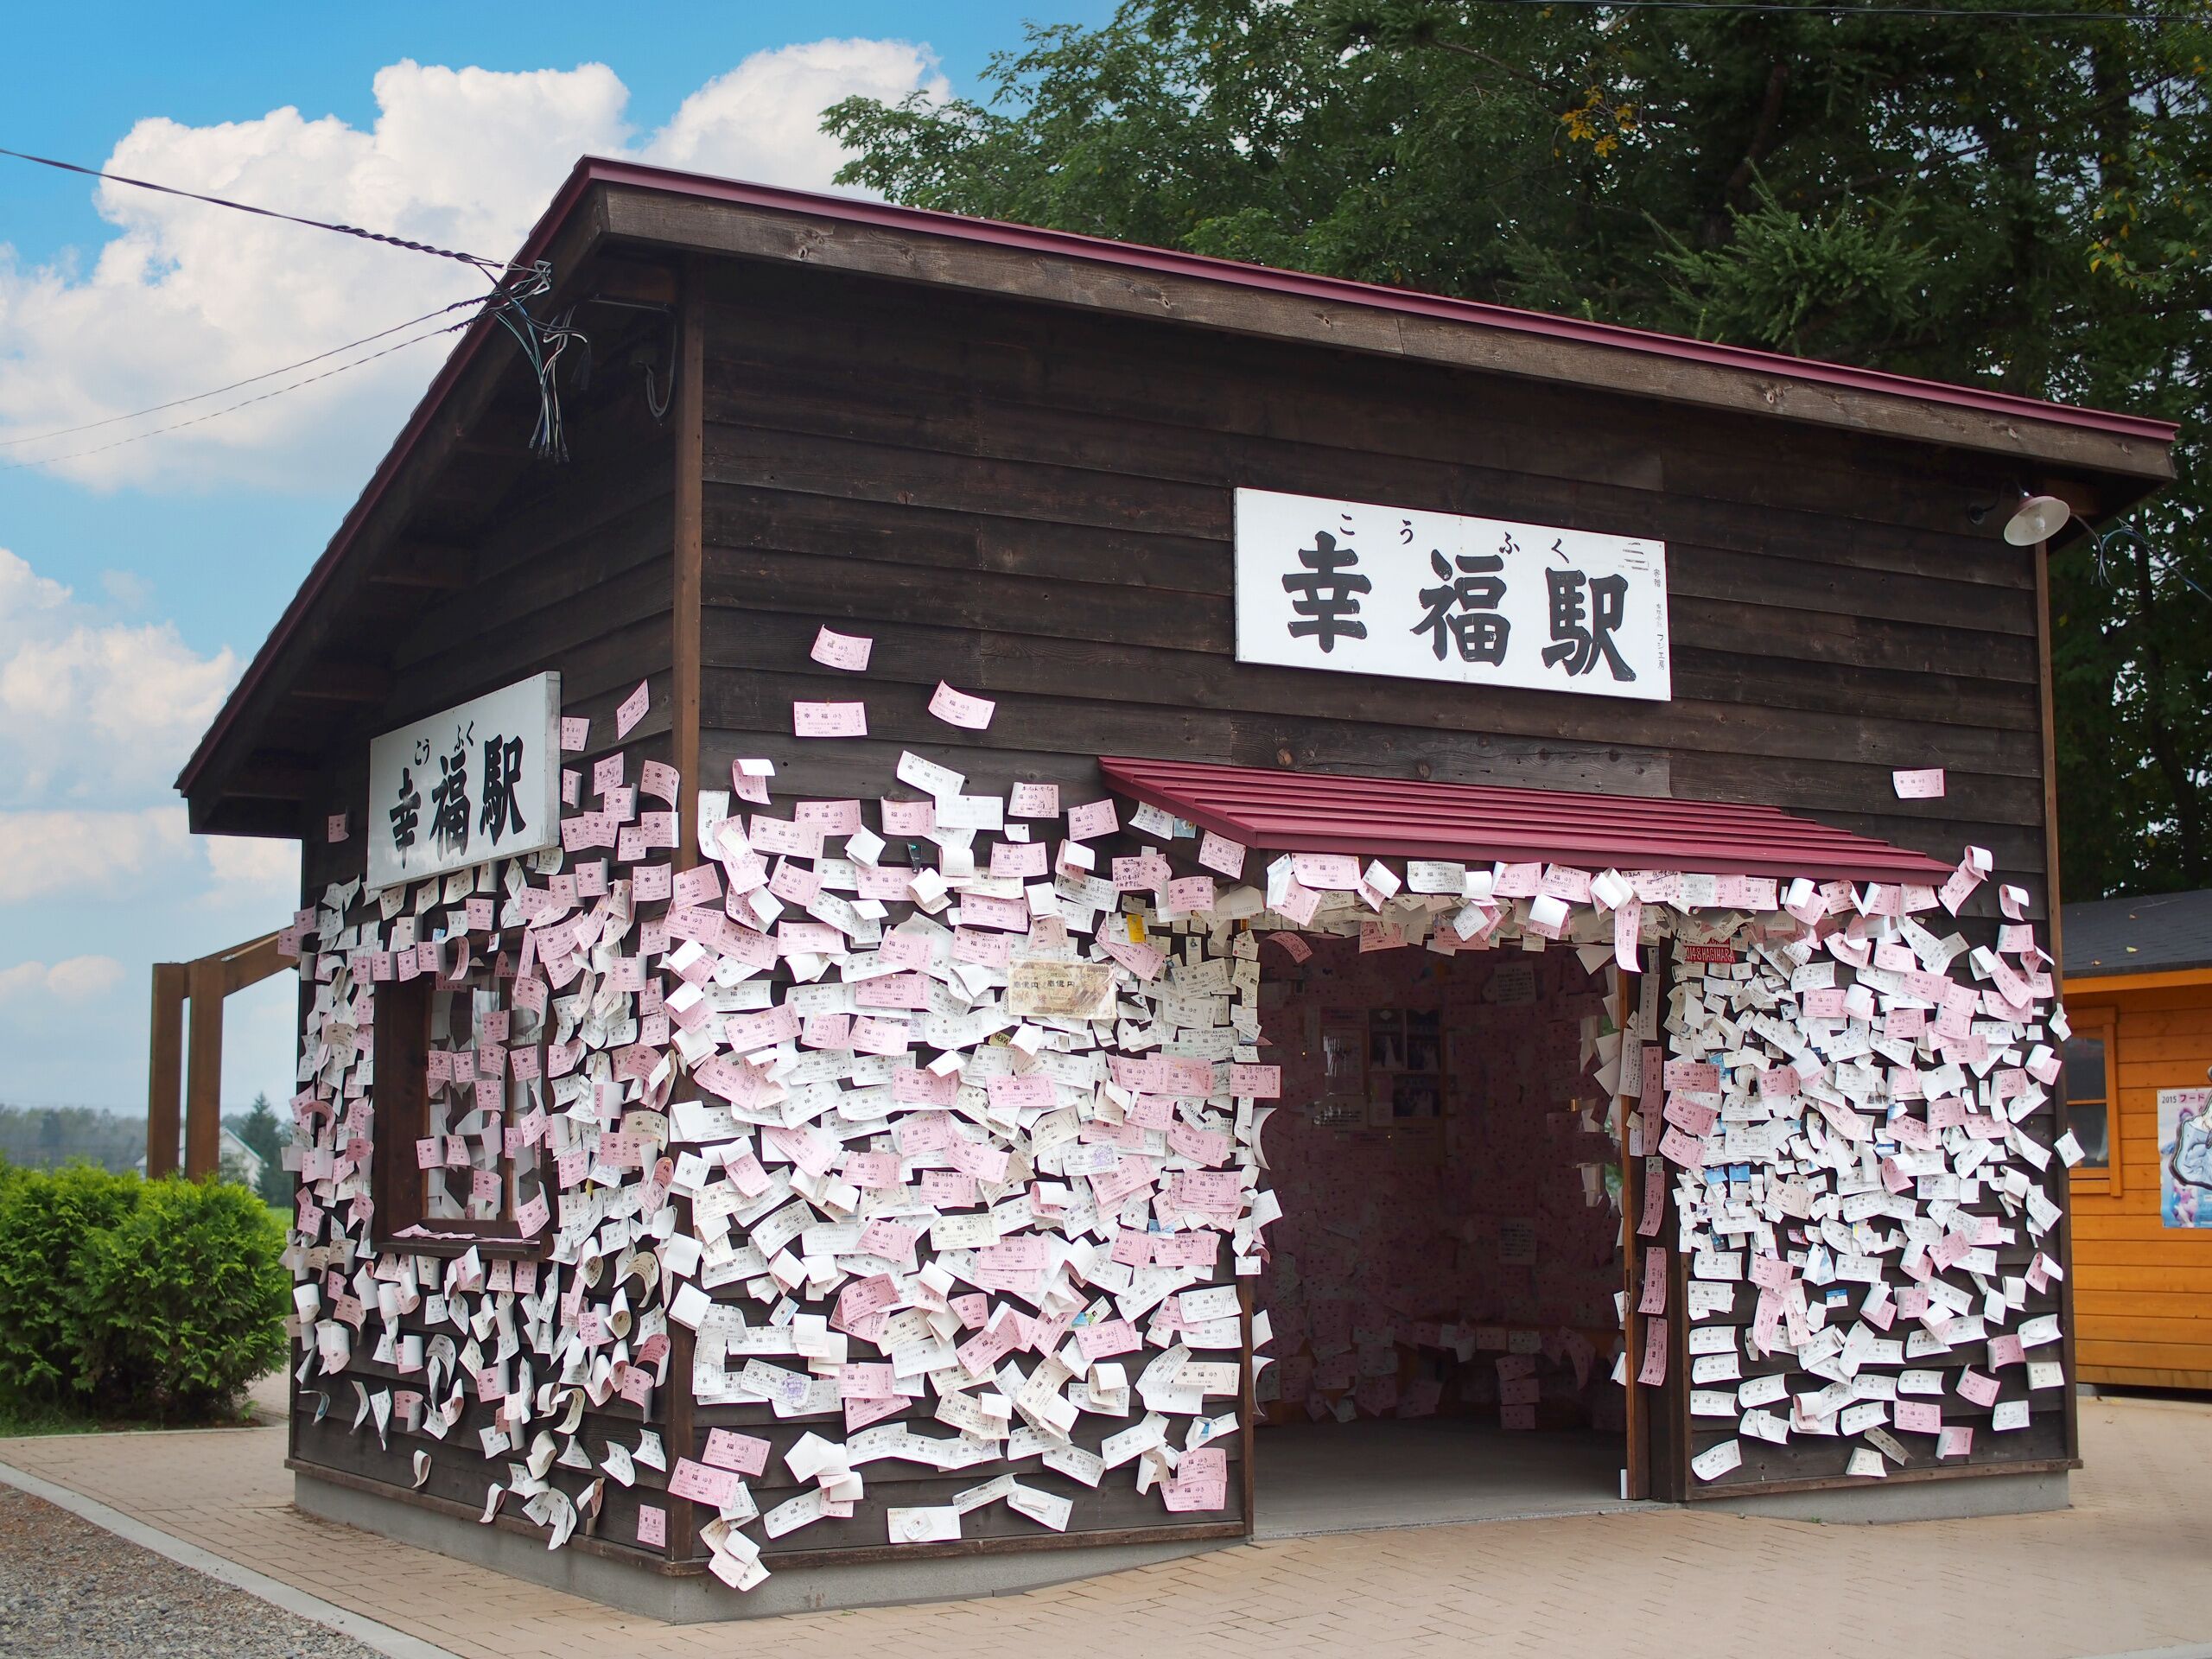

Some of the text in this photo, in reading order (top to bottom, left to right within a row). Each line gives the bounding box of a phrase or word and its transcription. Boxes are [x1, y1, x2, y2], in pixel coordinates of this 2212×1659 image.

[1340, 513, 1569, 564] こうふく
[1281, 531, 1637, 683] 幸福駅
[415, 720, 474, 766] こうふく
[389, 734, 526, 869] 幸福駅
